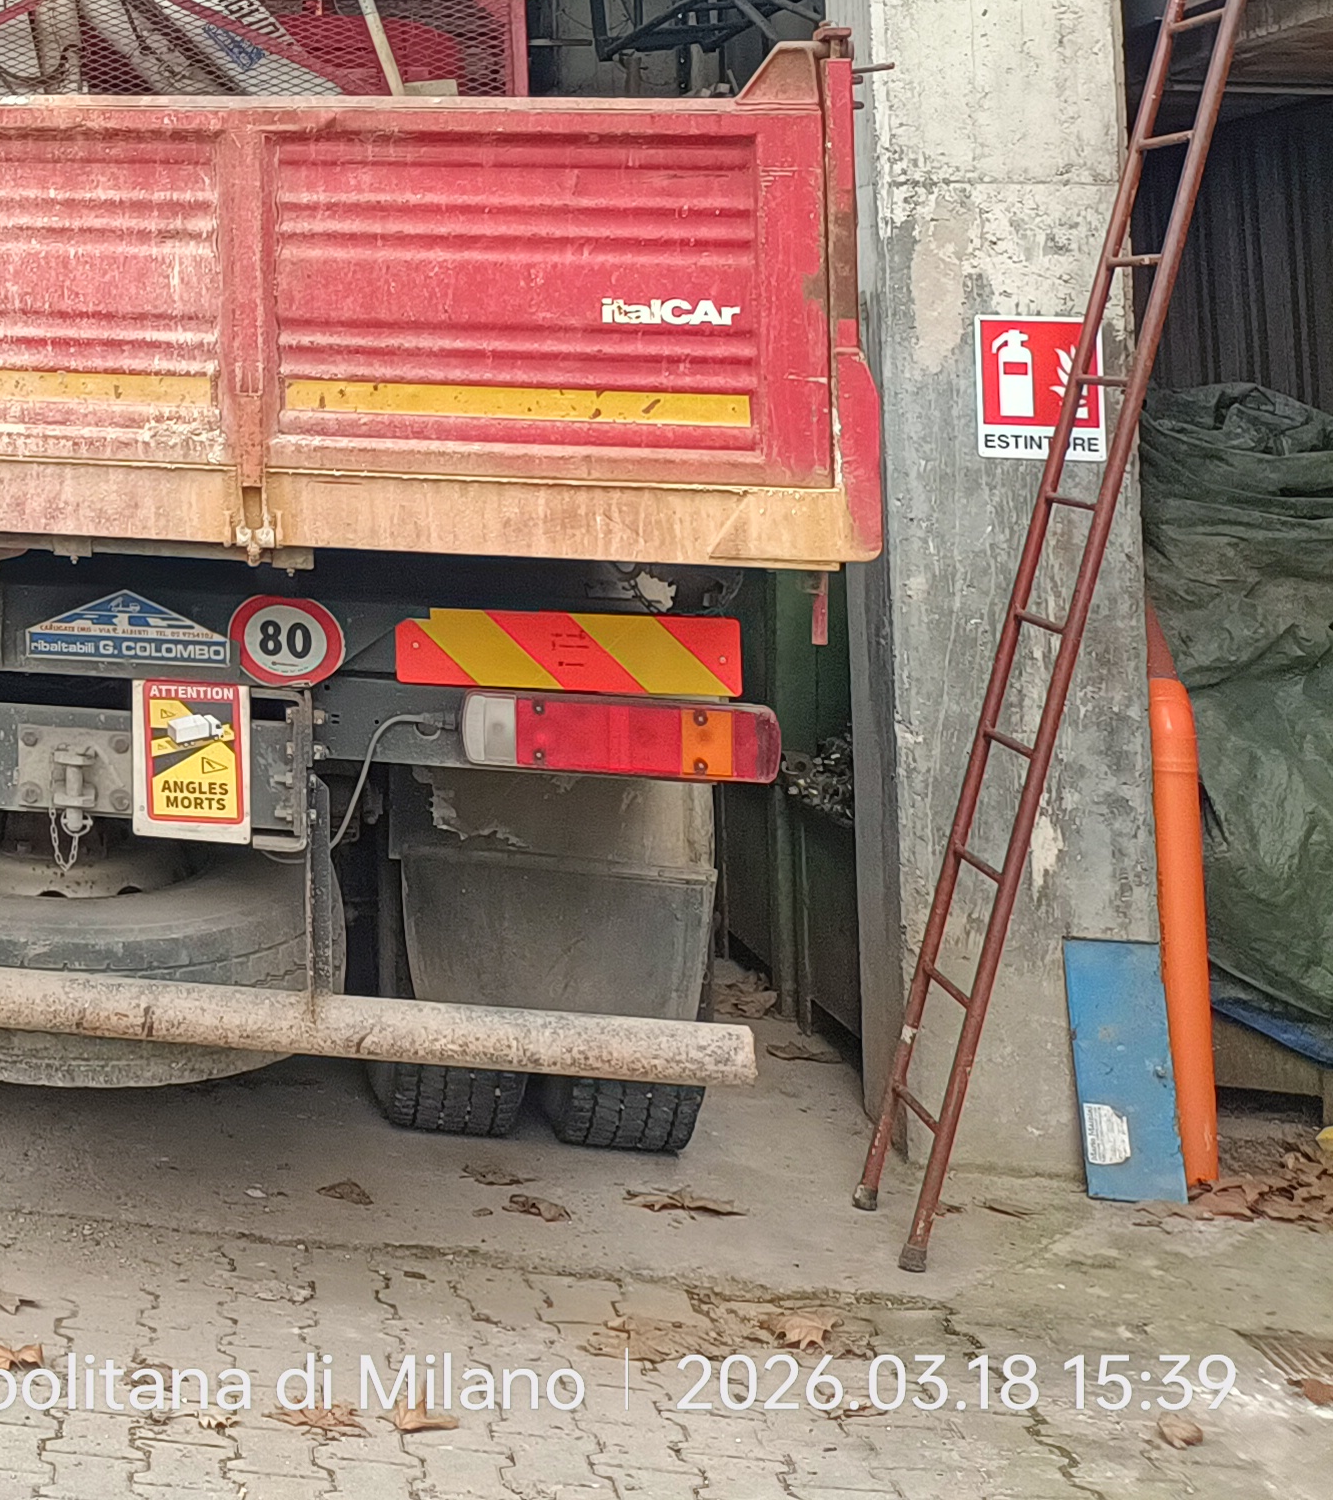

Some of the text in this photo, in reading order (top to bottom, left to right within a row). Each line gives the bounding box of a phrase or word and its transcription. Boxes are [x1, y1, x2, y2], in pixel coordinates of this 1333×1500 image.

[984, 433, 1100, 452] ESTINRE
[259, 619, 312, 659] 80
[31, 640, 224, 660] ribaltabili G. COLOMBO
[149, 685, 233, 700] ATTENTION
[161, 780, 229, 796] ANGLES
[166, 795, 226, 810] MORTS
